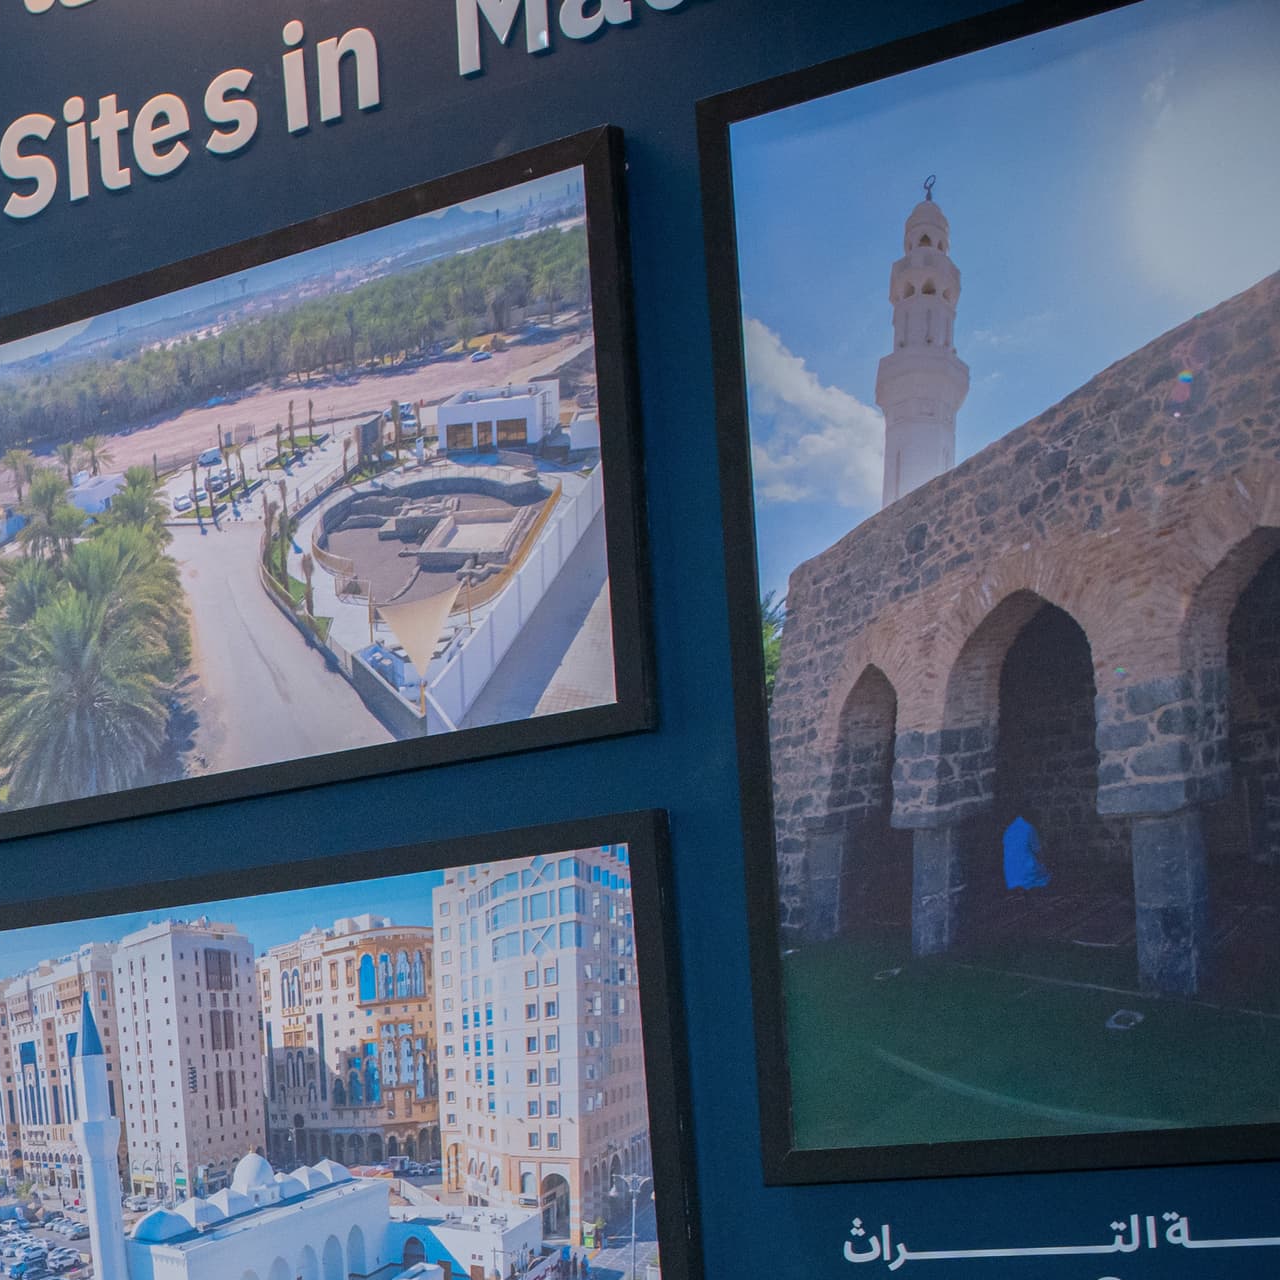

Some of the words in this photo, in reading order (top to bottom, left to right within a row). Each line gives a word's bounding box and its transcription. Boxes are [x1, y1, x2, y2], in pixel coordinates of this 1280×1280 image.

[282, 19, 381, 135] in
[454, 0, 686, 76] Ma
[843, 1214, 1157, 1271] التراث
